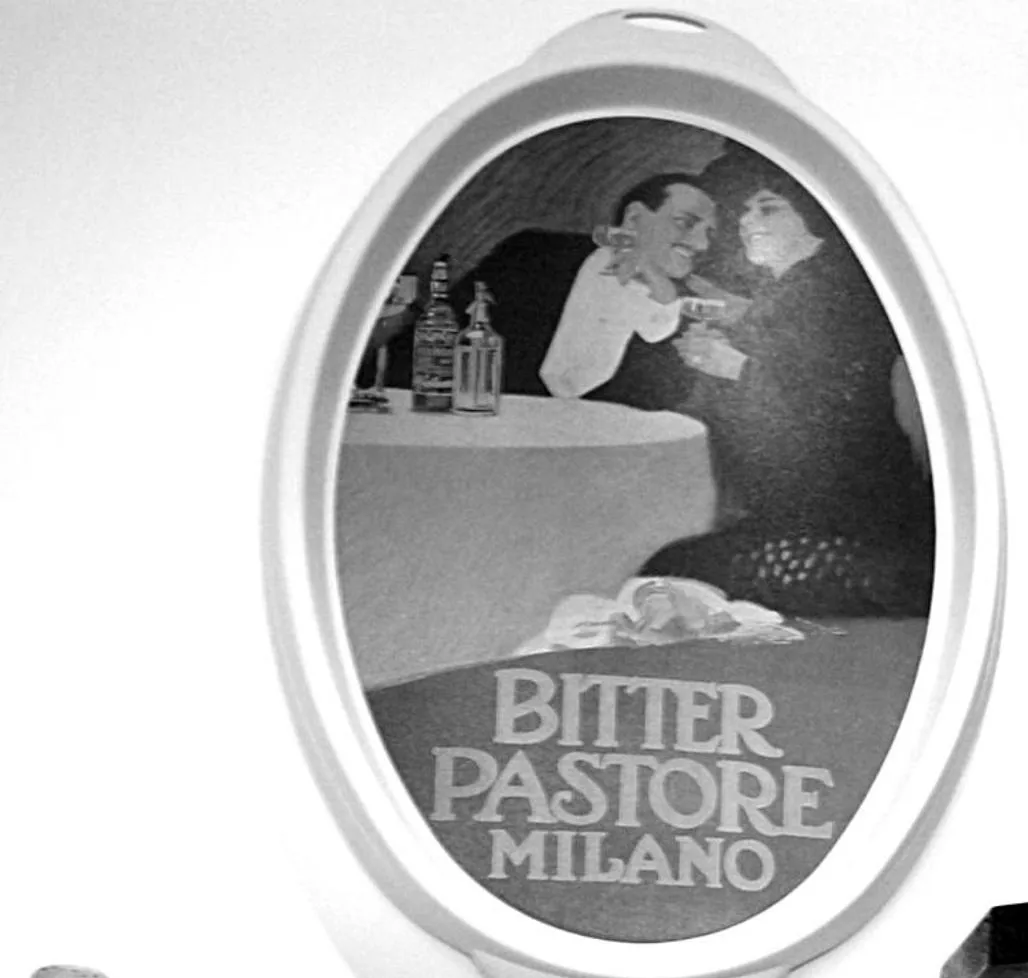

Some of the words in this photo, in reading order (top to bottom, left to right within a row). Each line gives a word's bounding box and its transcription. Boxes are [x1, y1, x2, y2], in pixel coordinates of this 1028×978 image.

[493, 668, 784, 758] BITTER
[429, 747, 835, 838] PASTORE
[487, 829, 775, 892] MILANO
